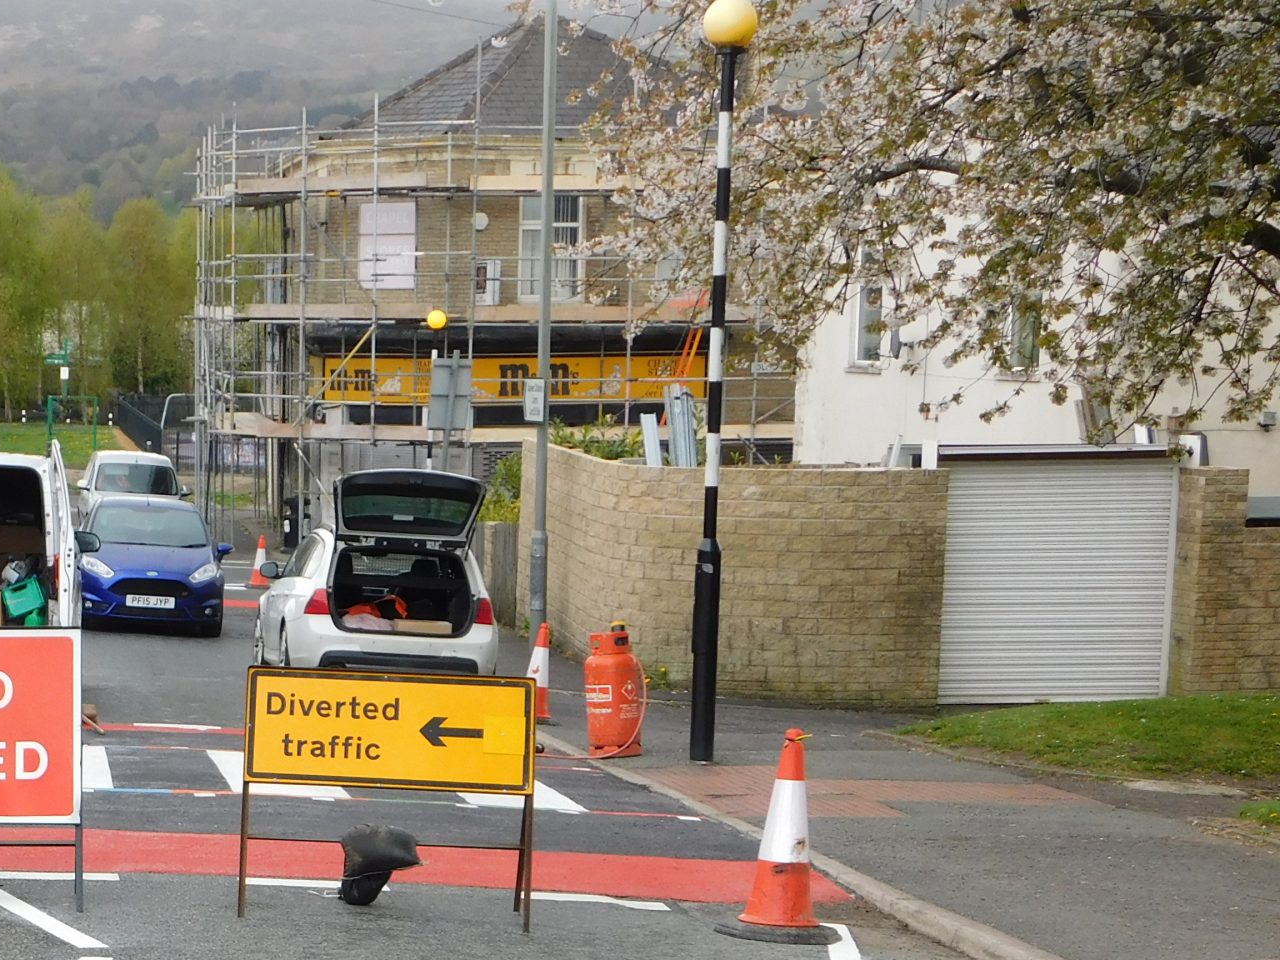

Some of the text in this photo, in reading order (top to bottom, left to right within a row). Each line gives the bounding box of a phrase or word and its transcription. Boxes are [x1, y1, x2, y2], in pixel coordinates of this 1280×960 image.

[131, 596, 170, 607] PF15 JYP
[266, 691, 401, 721] Diverted
[281, 733, 382, 761] traffic
